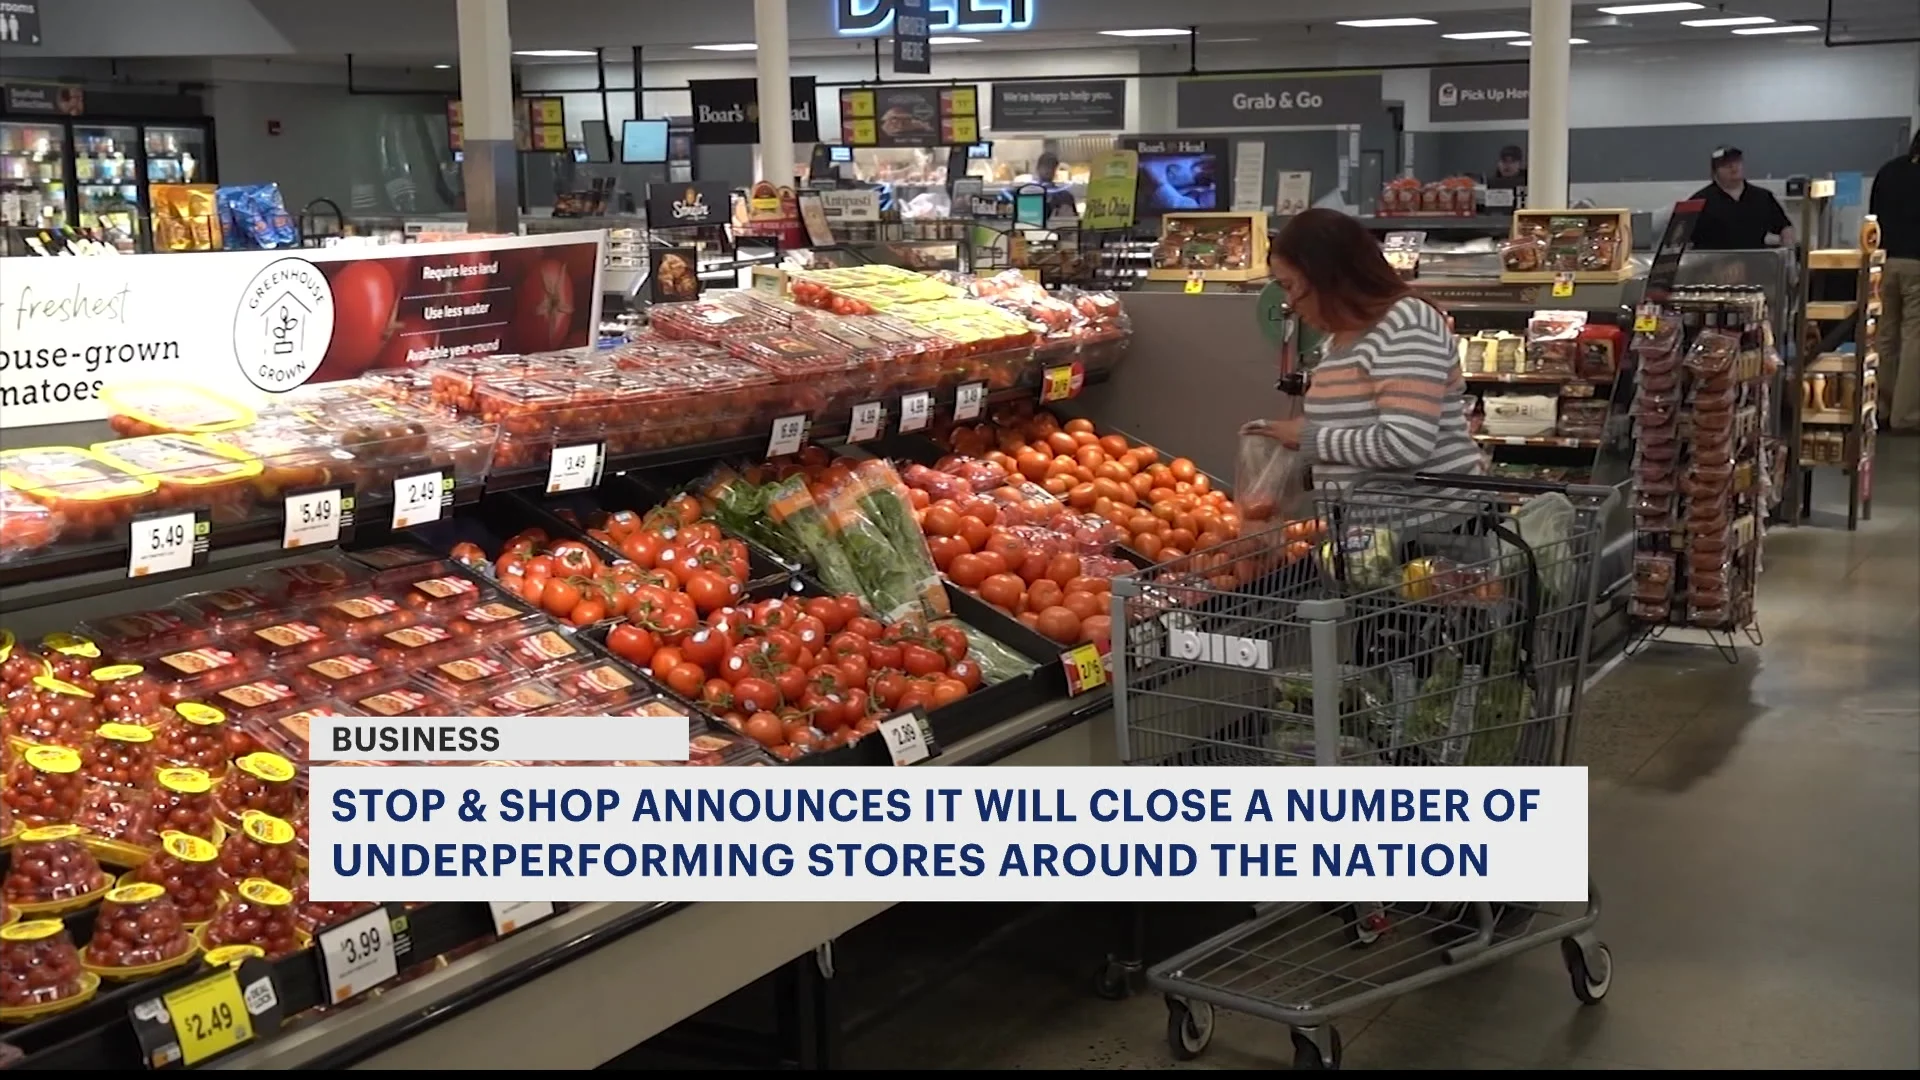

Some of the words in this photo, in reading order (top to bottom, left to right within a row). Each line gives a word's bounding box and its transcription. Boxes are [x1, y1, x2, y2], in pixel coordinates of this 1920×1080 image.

[1030, 91, 1058, 104] happy
[1070, 90, 1090, 103] help
[1233, 93, 1276, 110] Grab
[1279, 91, 1293, 108] &
[1296, 91, 1323, 108] Go
[1461, 89, 1485, 101] Pick
[1487, 89, 1505, 101] Up
[1506, 87, 1530, 100] Her
[699, 103, 745, 122] Boar's
[790, 101, 811, 121] ad
[1179, 141, 1205, 153] Head
[422, 265, 459, 281] Require
[460, 263, 478, 276] less
[479, 261, 499, 275] land
[249, 269, 325, 309] GREENHOUSE
[16, 282, 132, 331] freshest
[424, 306, 443, 320] Use
[443, 304, 463, 317] less
[463, 303, 490, 316] water
[0, 341, 180, 372] ouse-grown
[406, 346, 449, 362] Available
[449, 338, 500, 360] year-round
[259, 360, 307, 382] GROWN
[184, 1002, 233, 1041] $2.49
